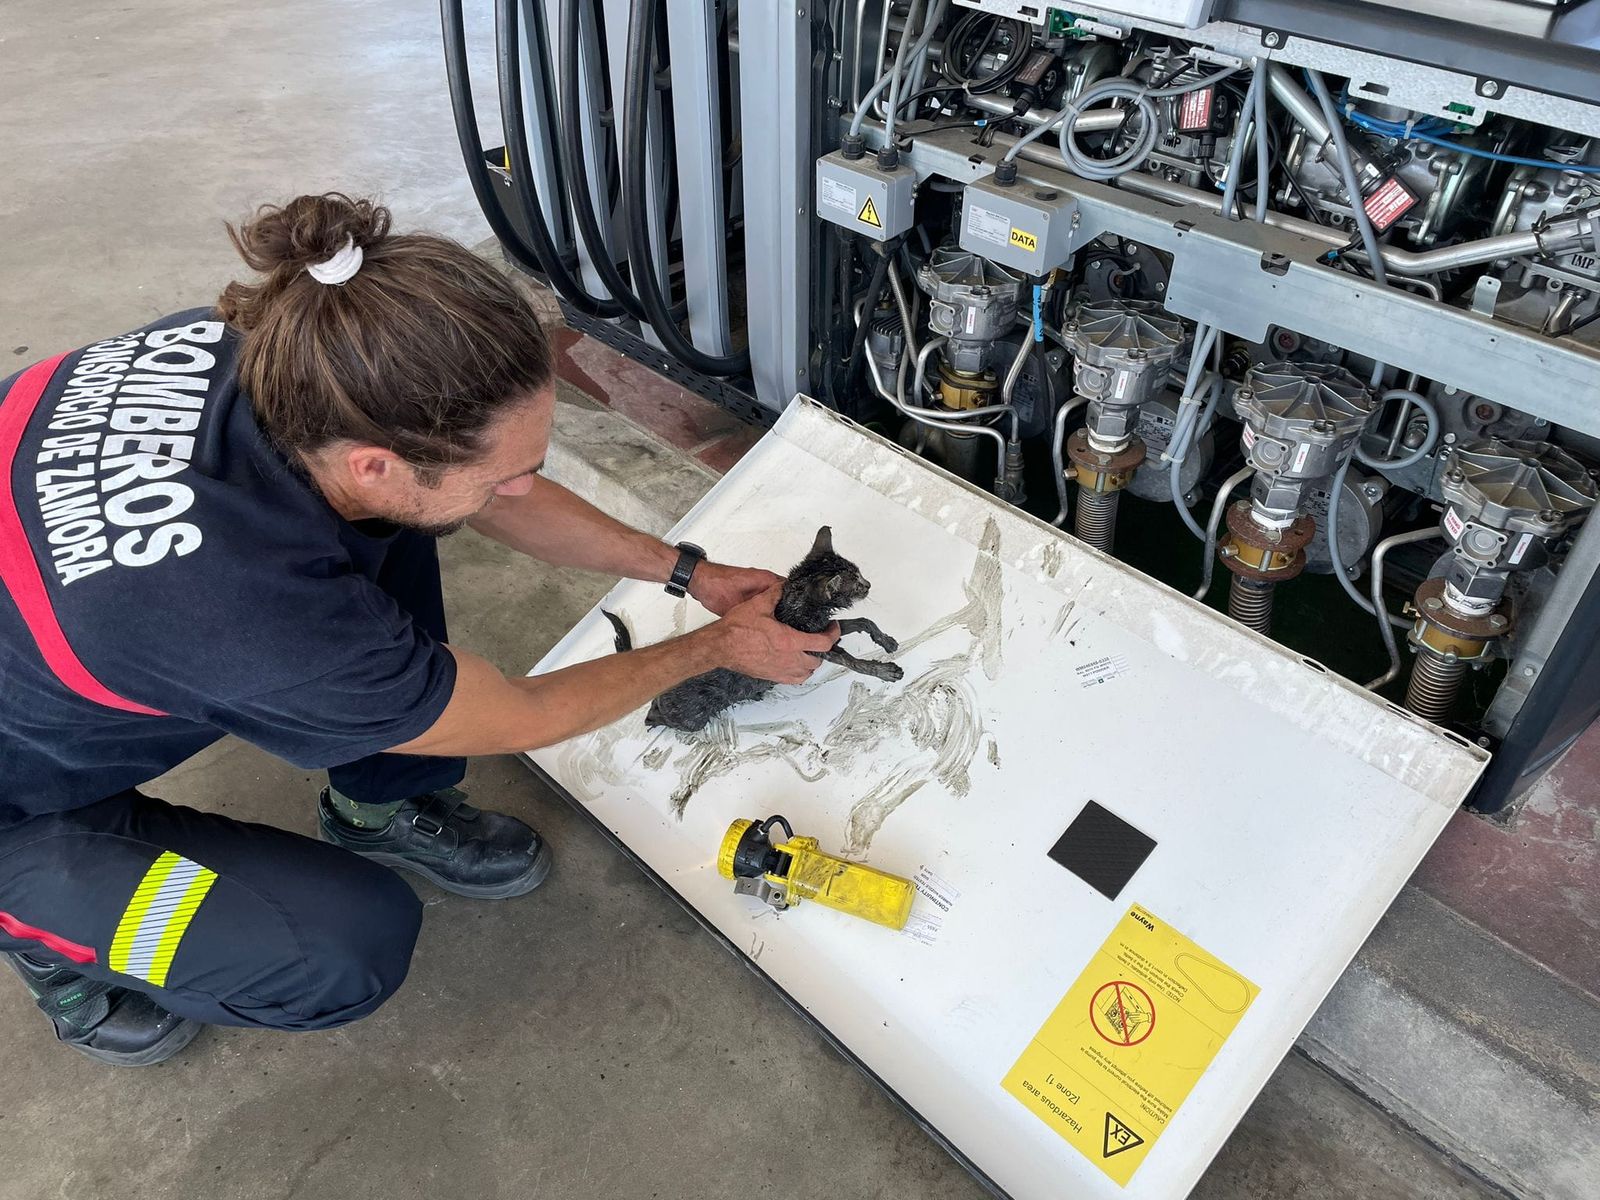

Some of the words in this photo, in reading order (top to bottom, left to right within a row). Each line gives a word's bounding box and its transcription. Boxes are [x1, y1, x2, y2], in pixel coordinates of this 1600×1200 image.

[1011, 231, 1035, 248] DATA
[1571, 254, 1594, 268] IMP
[36, 432, 101, 464] DE
[101, 320, 225, 567] BOMBEROS
[36, 462, 113, 586] ZAMORA
[920, 889, 949, 912] CONTINUITY
[1130, 911, 1154, 931] Wayne
[1128, 948, 1145, 961] distance
[1129, 964, 1148, 978] antistatic
[1148, 970, 1164, 983] tension
[1147, 976, 1157, 985] only
[1156, 983, 1165, 991] Use
[1167, 976, 1188, 992] Deflection
[1171, 986, 1184, 997] Check
[1084, 1050, 1096, 1061] pump
[1103, 1057, 1112, 1065] any
[1106, 1068, 1122, 1081] current
[1110, 1063, 1127, 1077] attempt
[1126, 1075, 1135, 1083] you
[1022, 1080, 1040, 1097] area
[1120, 1079, 1140, 1095] electrical
[1134, 1081, 1148, 1094] before
[1146, 1099, 1157, 1108] sure
[1153, 1096, 1172, 1112] switched
[1040, 1095, 1082, 1133] Hazardous
[1139, 1102, 1165, 1124] CAUTION!
[1156, 1107, 1168, 1118] Make
[1109, 1123, 1131, 1145] EX
